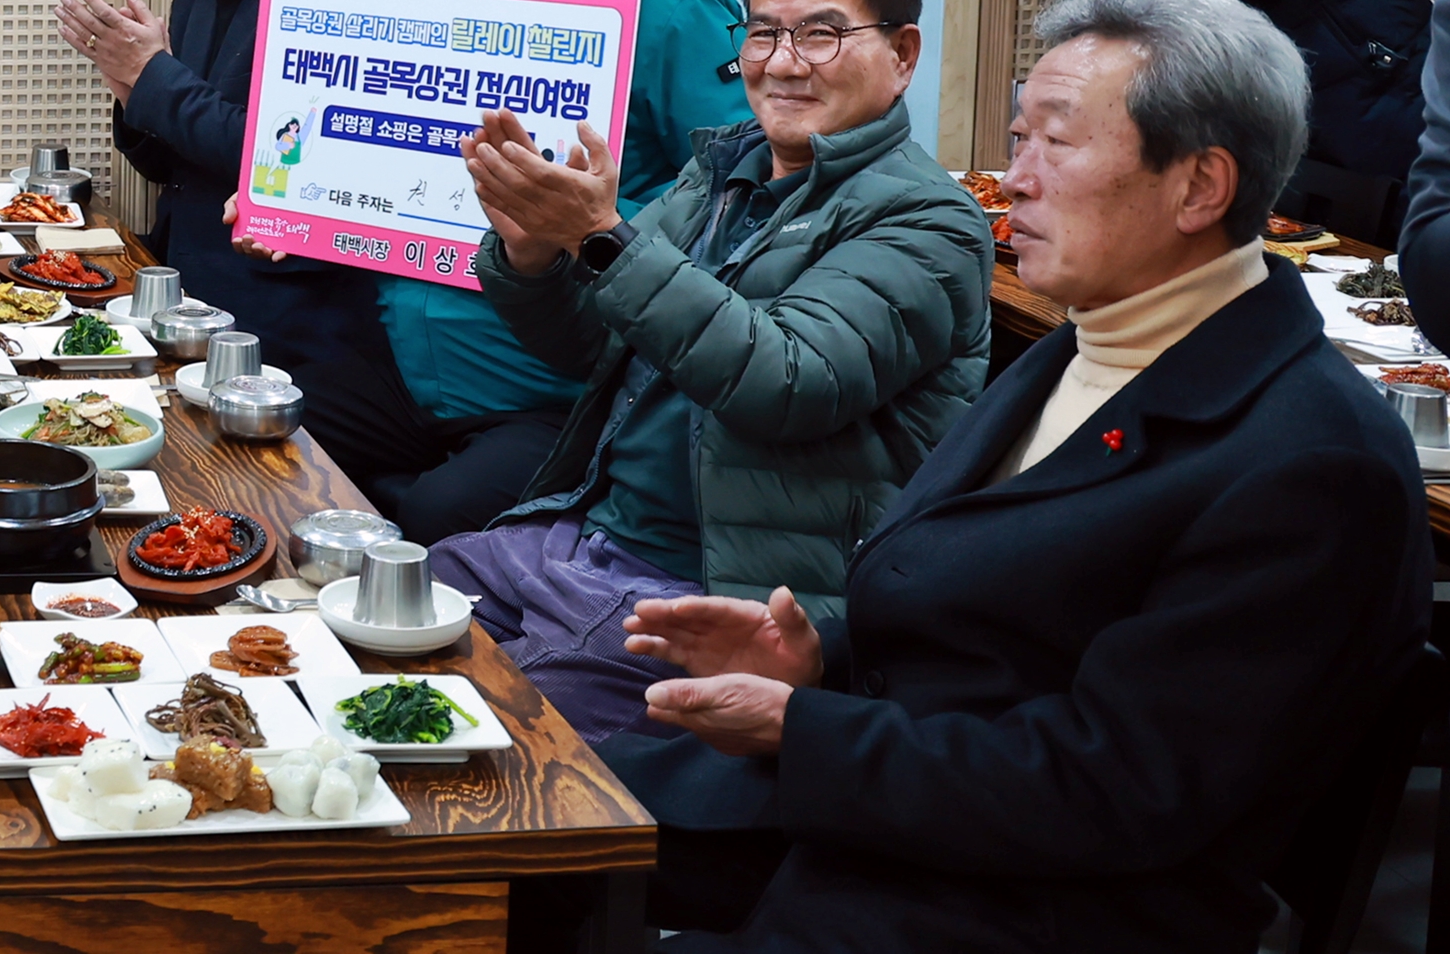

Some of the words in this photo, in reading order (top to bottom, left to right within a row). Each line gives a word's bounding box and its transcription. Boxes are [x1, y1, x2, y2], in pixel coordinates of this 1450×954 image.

[279, 6, 343, 36] 골목상권
[345, 13, 395, 42] 살리기
[396, 19, 449, 47] 캠페인
[451, 18, 524, 57] 릴레이
[527, 23, 605, 67] 챌린지
[281, 48, 358, 92] 태백시
[362, 57, 470, 105] 골목상권
[475, 70, 591, 121] 점심여행
[329, 111, 374, 139] 설명절
[376, 118, 423, 145] 쇼핑은
[328, 189, 354, 207] 다음
[356, 193, 395, 214] 주자는
[332, 233, 391, 261] 태백시장
